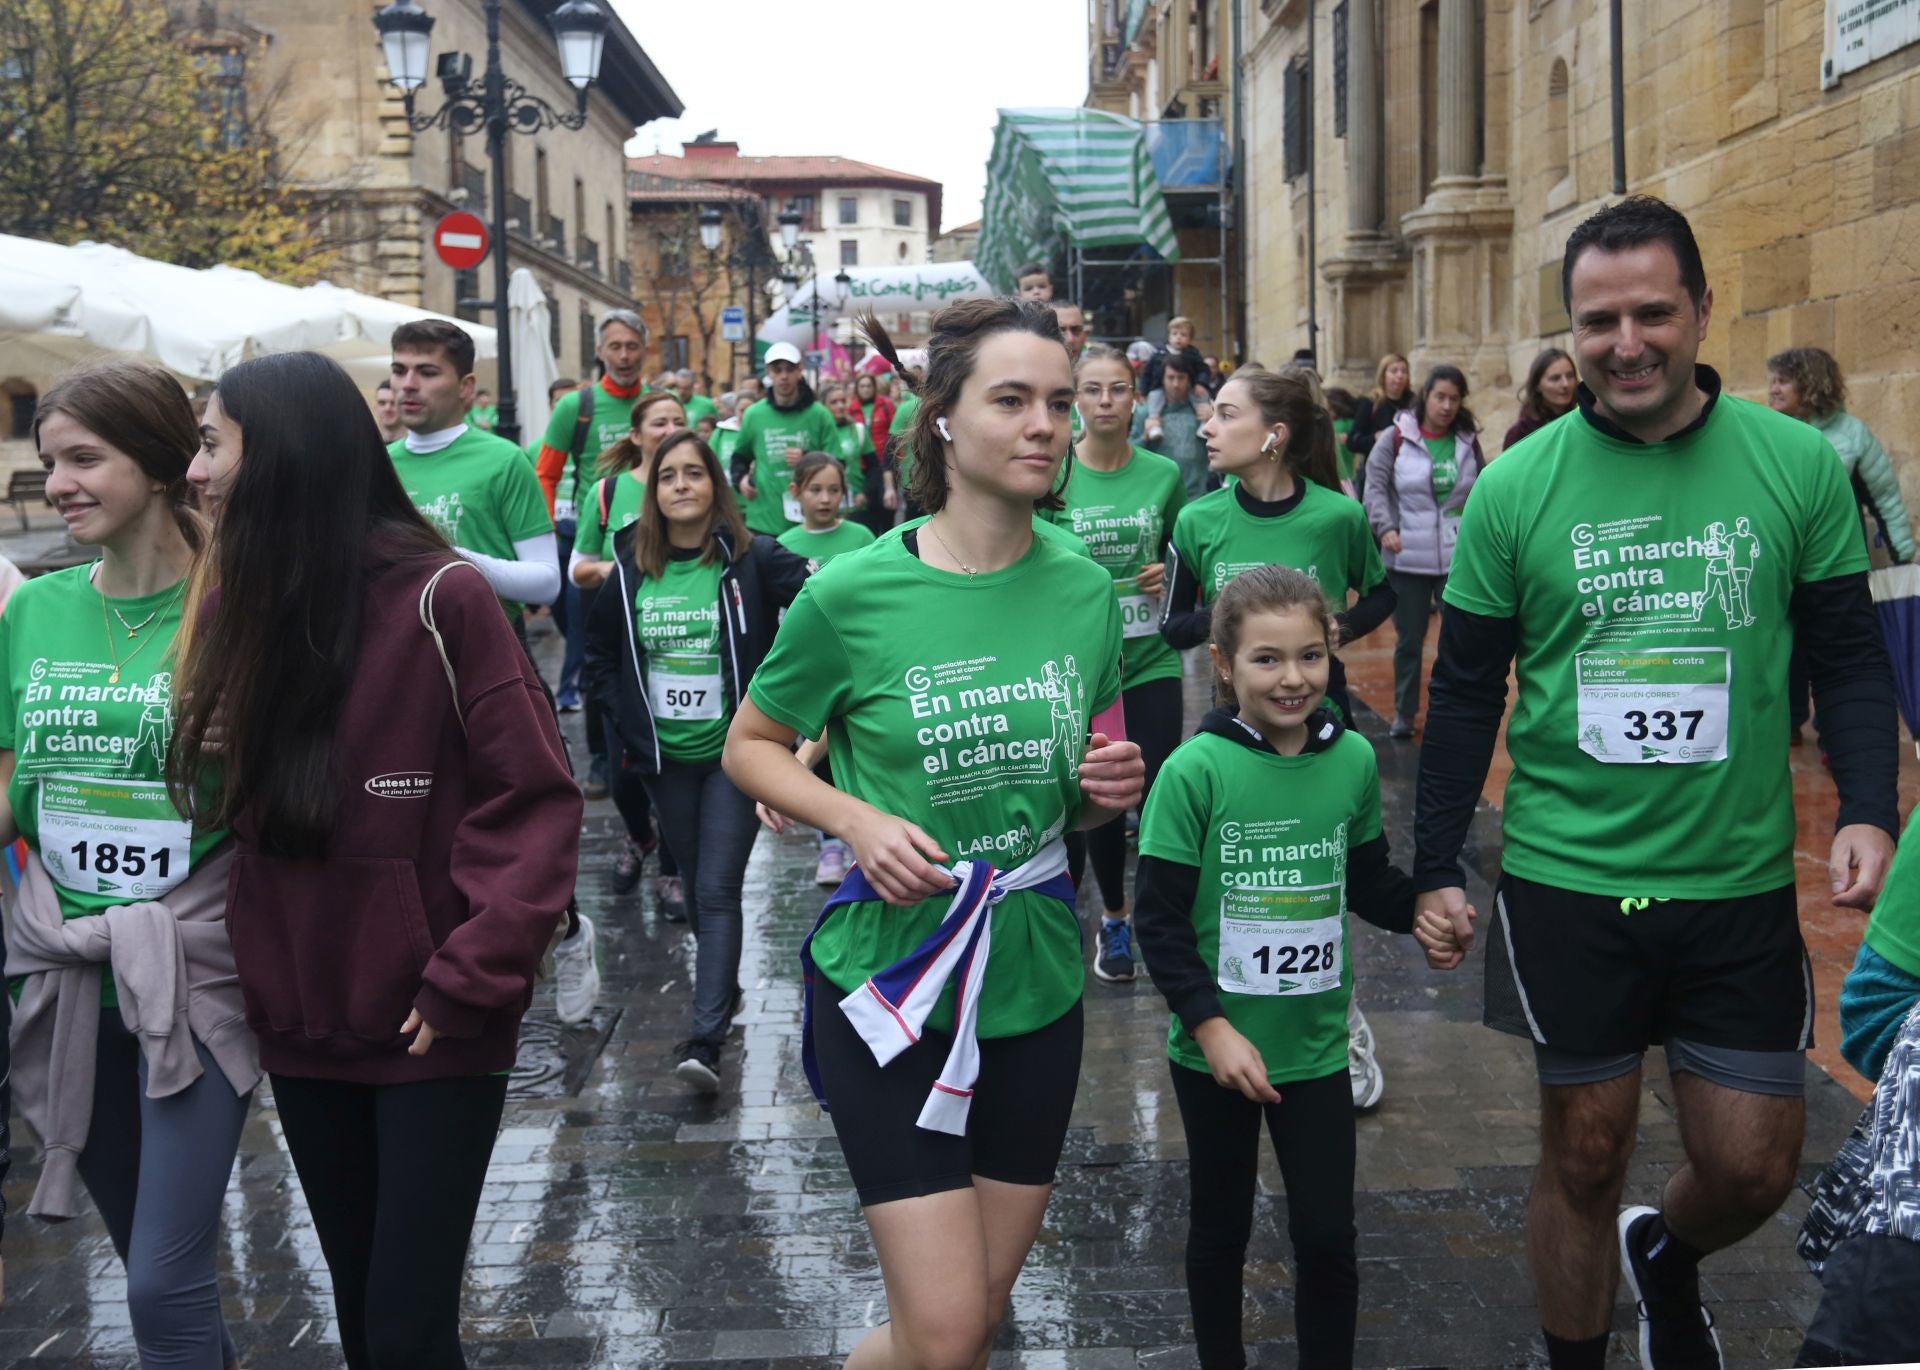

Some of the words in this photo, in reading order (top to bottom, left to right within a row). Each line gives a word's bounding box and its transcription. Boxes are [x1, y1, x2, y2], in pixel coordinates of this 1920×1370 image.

[916, 274, 976, 301] Inglés
[1073, 520, 1091, 533] En
[1096, 516, 1146, 529] marcha
[1598, 518, 1632, 528] asociación
[1632, 515, 1662, 524] española
[1598, 526, 1619, 534] contra
[1083, 531, 1118, 544] ontra
[1608, 532, 1634, 540] Asturias
[1092, 543, 1138, 555] cáncer
[1573, 547, 1610, 570] En
[1619, 536, 1719, 562] marcha
[1577, 566, 1664, 594] contra
[1581, 595, 1605, 617] el
[1612, 590, 1702, 614] cáncer
[642, 610, 659, 622] En
[664, 608, 720, 621] marcha
[642, 623, 686, 636] contra
[660, 637, 711, 649] cáncer
[932, 660, 967, 671] asociación
[968, 656, 996, 665] española
[934, 669, 956, 678] contra
[946, 675, 972, 684] Asturias
[25, 682, 52, 703] En
[60, 683, 159, 702] marcha
[666, 689, 707, 707] 507
[909, 692, 951, 719] En
[959, 676, 1059, 709] marcha
[23, 705, 97, 728] contra
[917, 712, 1009, 745] contra
[1624, 710, 1704, 741] 337
[46, 730, 136, 754] cáncer
[923, 747, 949, 774] el
[957, 737, 1052, 768] cáncer
[372, 778, 410, 787] Latest
[926, 776, 952, 786] ASTURIAS
[960, 771, 980, 780] MARCHA
[982, 766, 1000, 775] CONTRA
[46, 783, 78, 794] Oviedo
[132, 792, 165, 800] contra
[930, 790, 960, 801] ASOCIACIÓN
[56, 796, 87, 806] cáncer
[71, 840, 170, 878] 1851
[1220, 844, 1252, 864] En
[1220, 867, 1302, 886] contra
[1227, 893, 1259, 902] Oviedo
[1310, 893, 1330, 902] contra
[1238, 905, 1269, 913] cáncer
[1253, 942, 1334, 974] 1228
